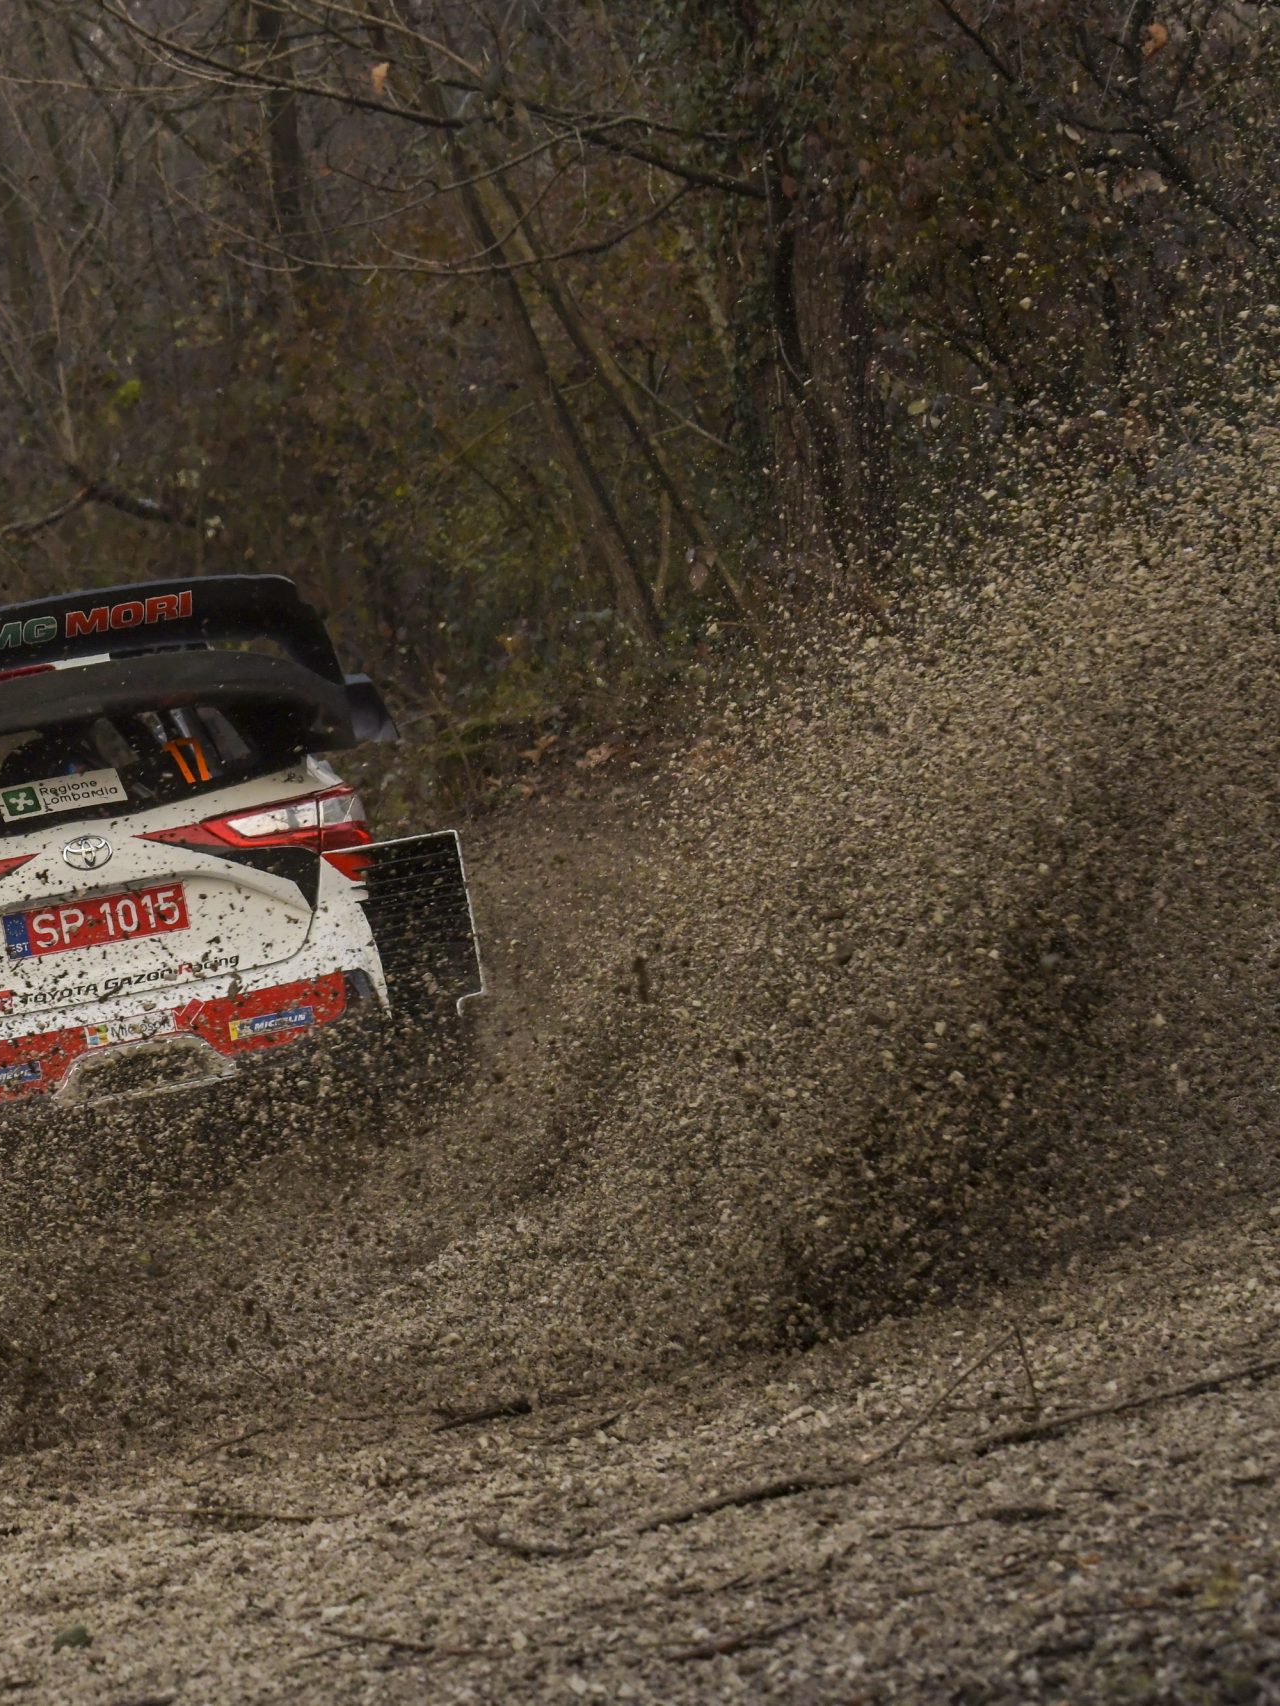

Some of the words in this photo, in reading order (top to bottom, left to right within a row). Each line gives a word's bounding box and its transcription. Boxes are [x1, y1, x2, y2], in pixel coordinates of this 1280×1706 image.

[65, 590, 192, 638] MORI
[39, 780, 98, 796] Regione
[43, 785, 118, 805] Lombardia
[32, 908, 84, 948] SP
[99, 891, 180, 936] 1015
[23, 983, 98, 1003] TOYOTA
[111, 1015, 171, 1038] Micosoft
[254, 1014, 306, 1031] MICLIN
